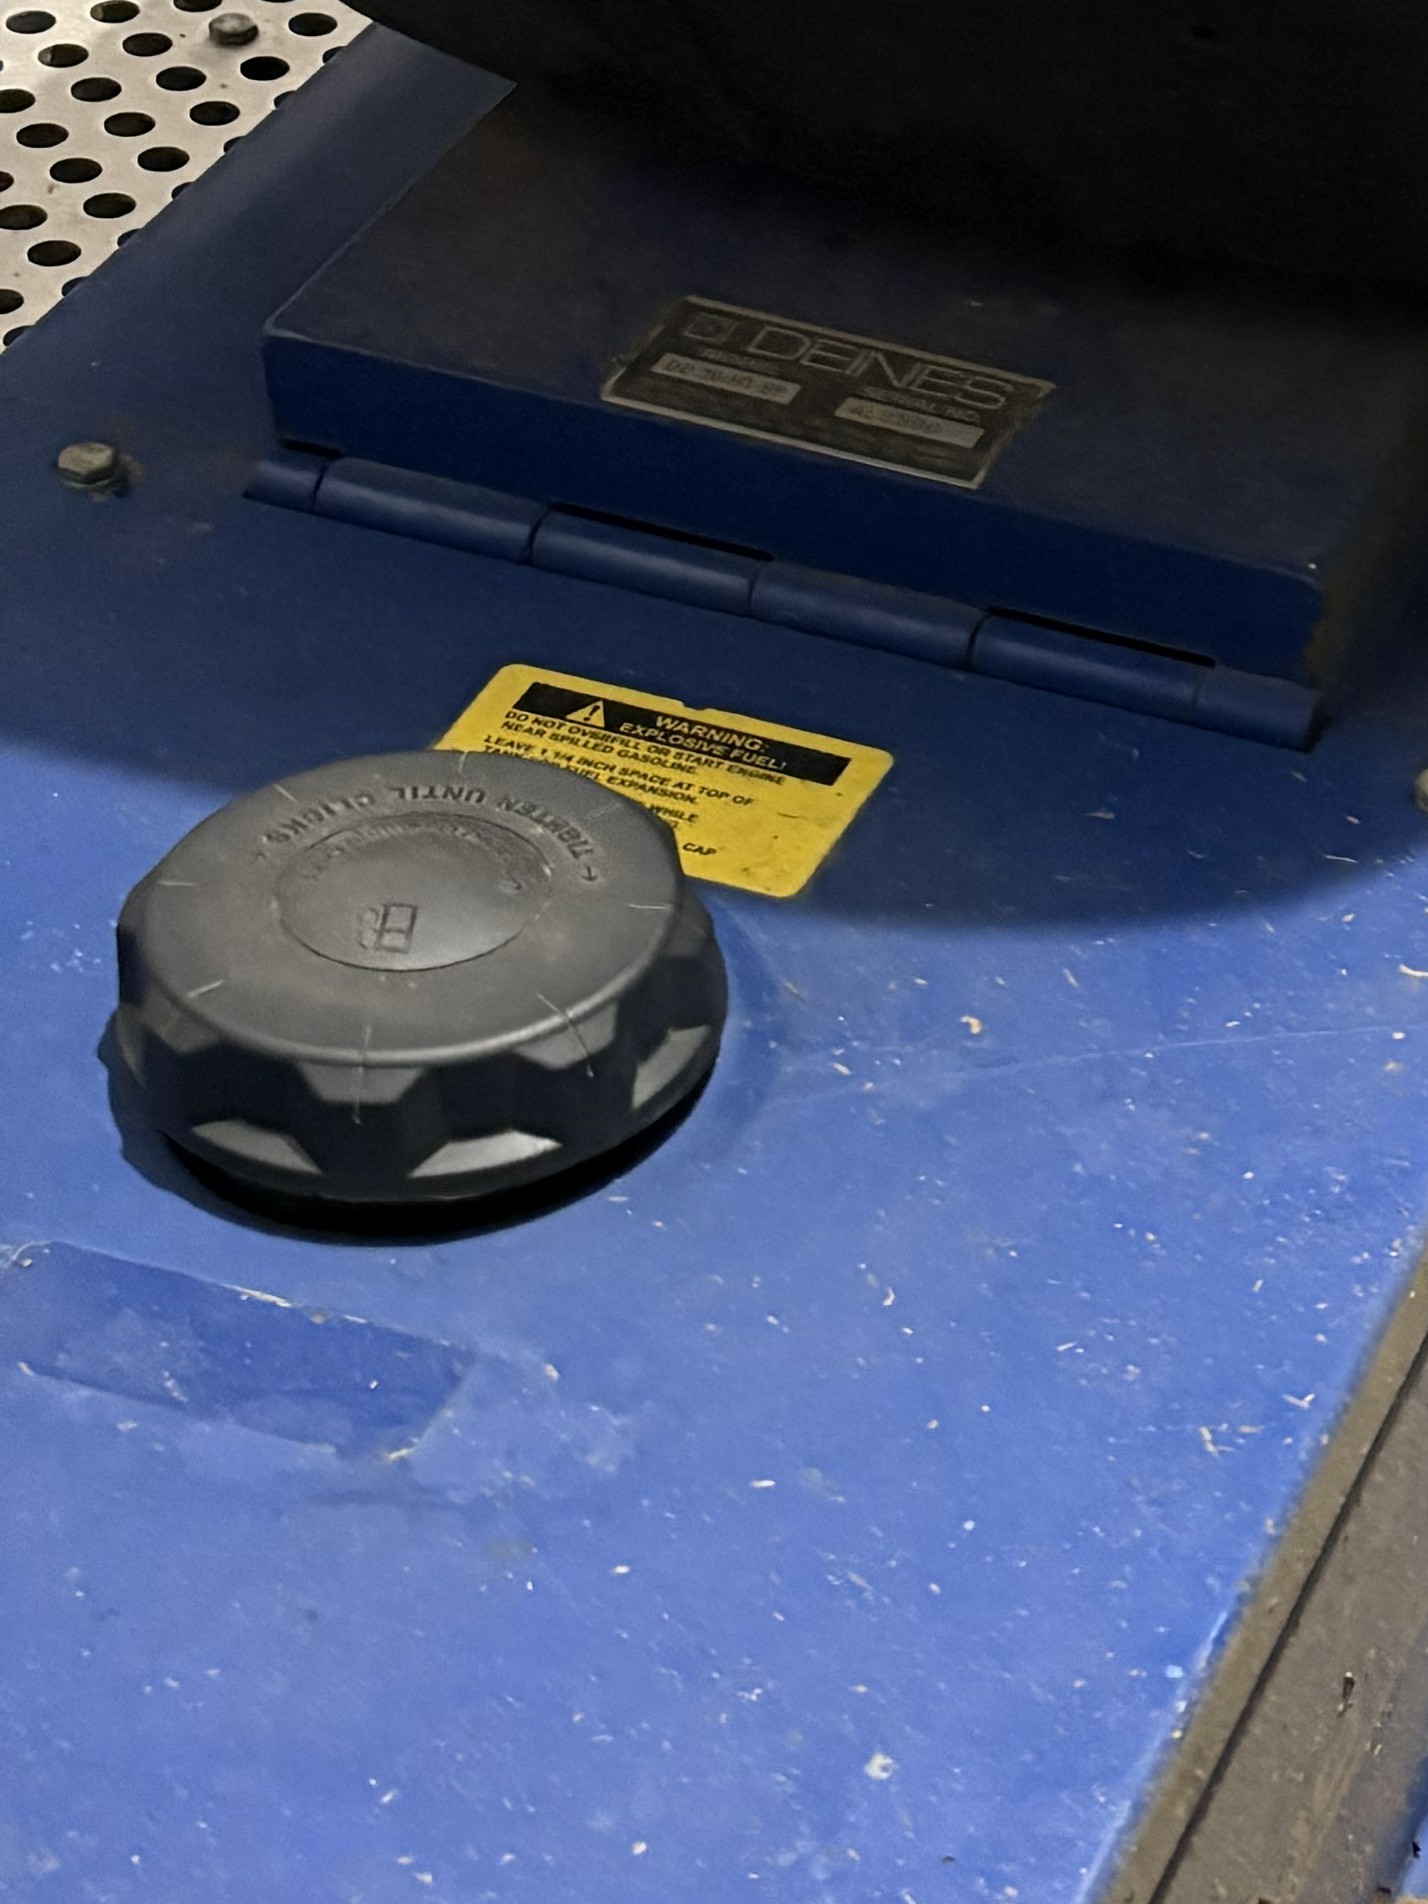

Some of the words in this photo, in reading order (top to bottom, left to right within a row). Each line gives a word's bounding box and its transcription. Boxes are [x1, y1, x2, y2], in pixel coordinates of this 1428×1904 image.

[745, 324, 1016, 412] DEINES
[502, 721, 546, 739] NEAR
[548, 732, 613, 754] SPILLED
[505, 711, 529, 723] DO
[532, 716, 566, 730] NOT
[568, 724, 643, 749] OVERFILL
[648, 744, 669, 755] OR
[672, 749, 724, 769] START
[727, 763, 785, 784] ENGINE
[618, 722, 727, 758] EXPLOSIVE
[728, 747, 786, 770] FUEL!
[655, 714, 769, 753] WARNING:
[484, 735, 533, 755] LEAVE
[577, 757, 617, 771] INCH
[620, 766, 672, 786] SPACE
[675, 779, 696, 790] AT
[698, 785, 732, 799] TOP
[733, 794, 755, 806] OF
[390, 785, 489, 807] UNTIL
[649, 804, 699, 823] WHILE
[264, 793, 376, 846] CLICKS
[682, 841, 718, 856] CAP
